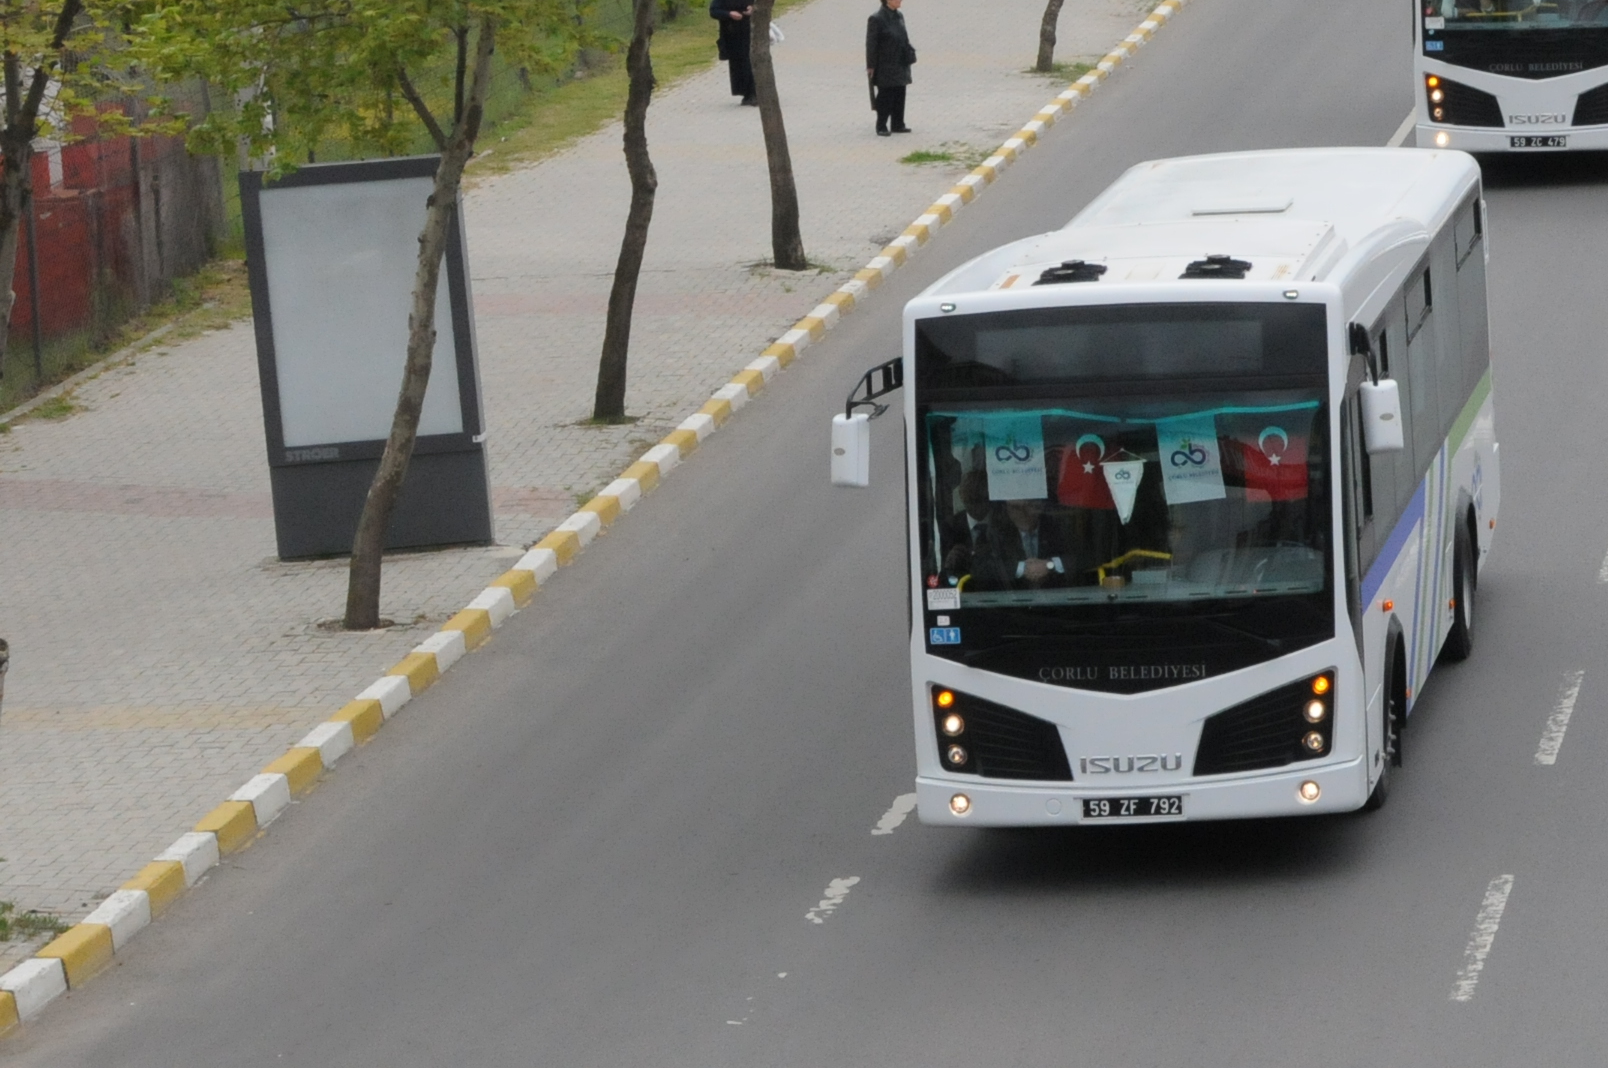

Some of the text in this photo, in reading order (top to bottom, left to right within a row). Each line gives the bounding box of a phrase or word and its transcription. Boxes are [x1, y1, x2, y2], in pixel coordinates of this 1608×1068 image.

[1508, 112, 1567, 125] ISUZU
[1513, 136, 1566, 147] 59 ZC 479
[1038, 660, 1207, 683] ÇORLU BELEDİYESİ
[1079, 752, 1183, 774] ISUZU
[1089, 797, 1180, 817] 59 ZF 792
